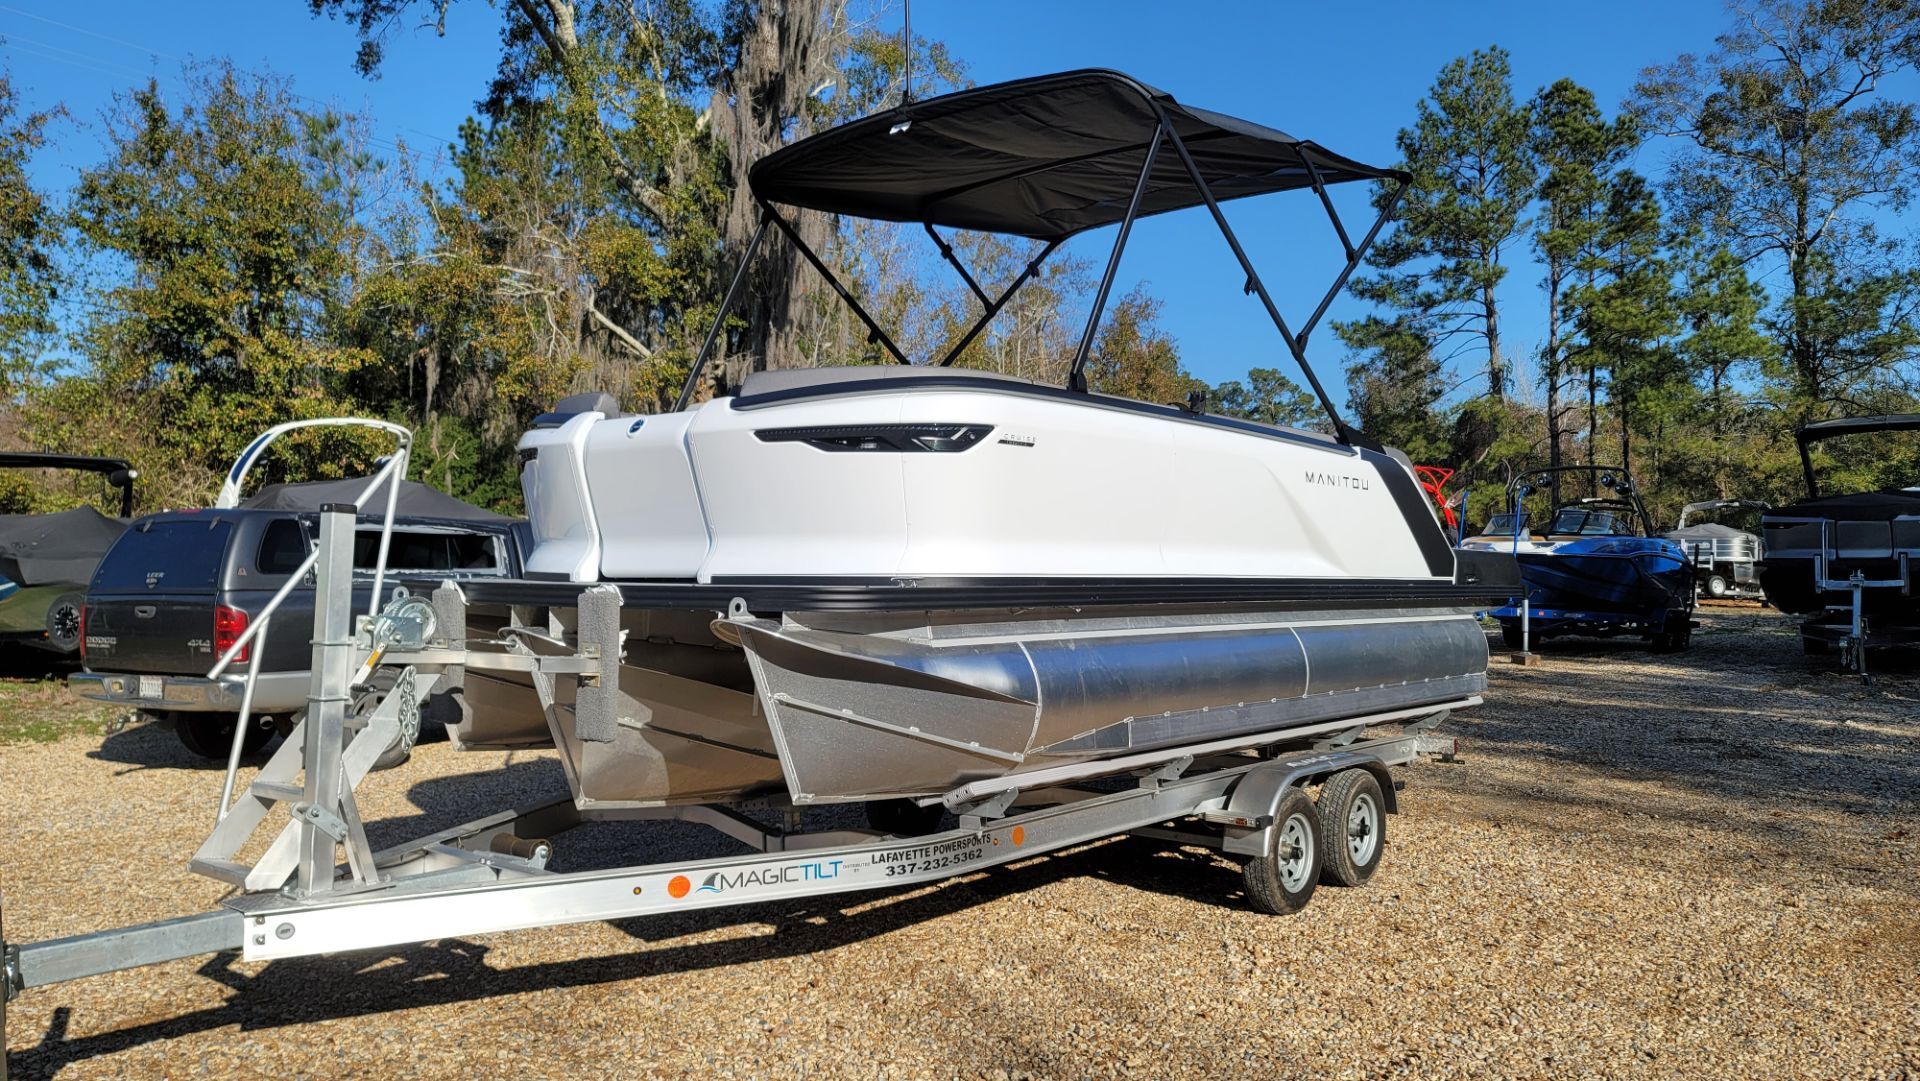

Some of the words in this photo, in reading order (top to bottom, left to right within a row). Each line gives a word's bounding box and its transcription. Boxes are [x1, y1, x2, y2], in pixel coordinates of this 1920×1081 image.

[1305, 471, 1369, 490] MANITOU
[871, 847, 931, 866] LAFAYETTE
[933, 833, 992, 857] POWERSPORTS
[884, 848, 984, 878] 337-232-5362
[719, 860, 844, 891] MAGICTILT
